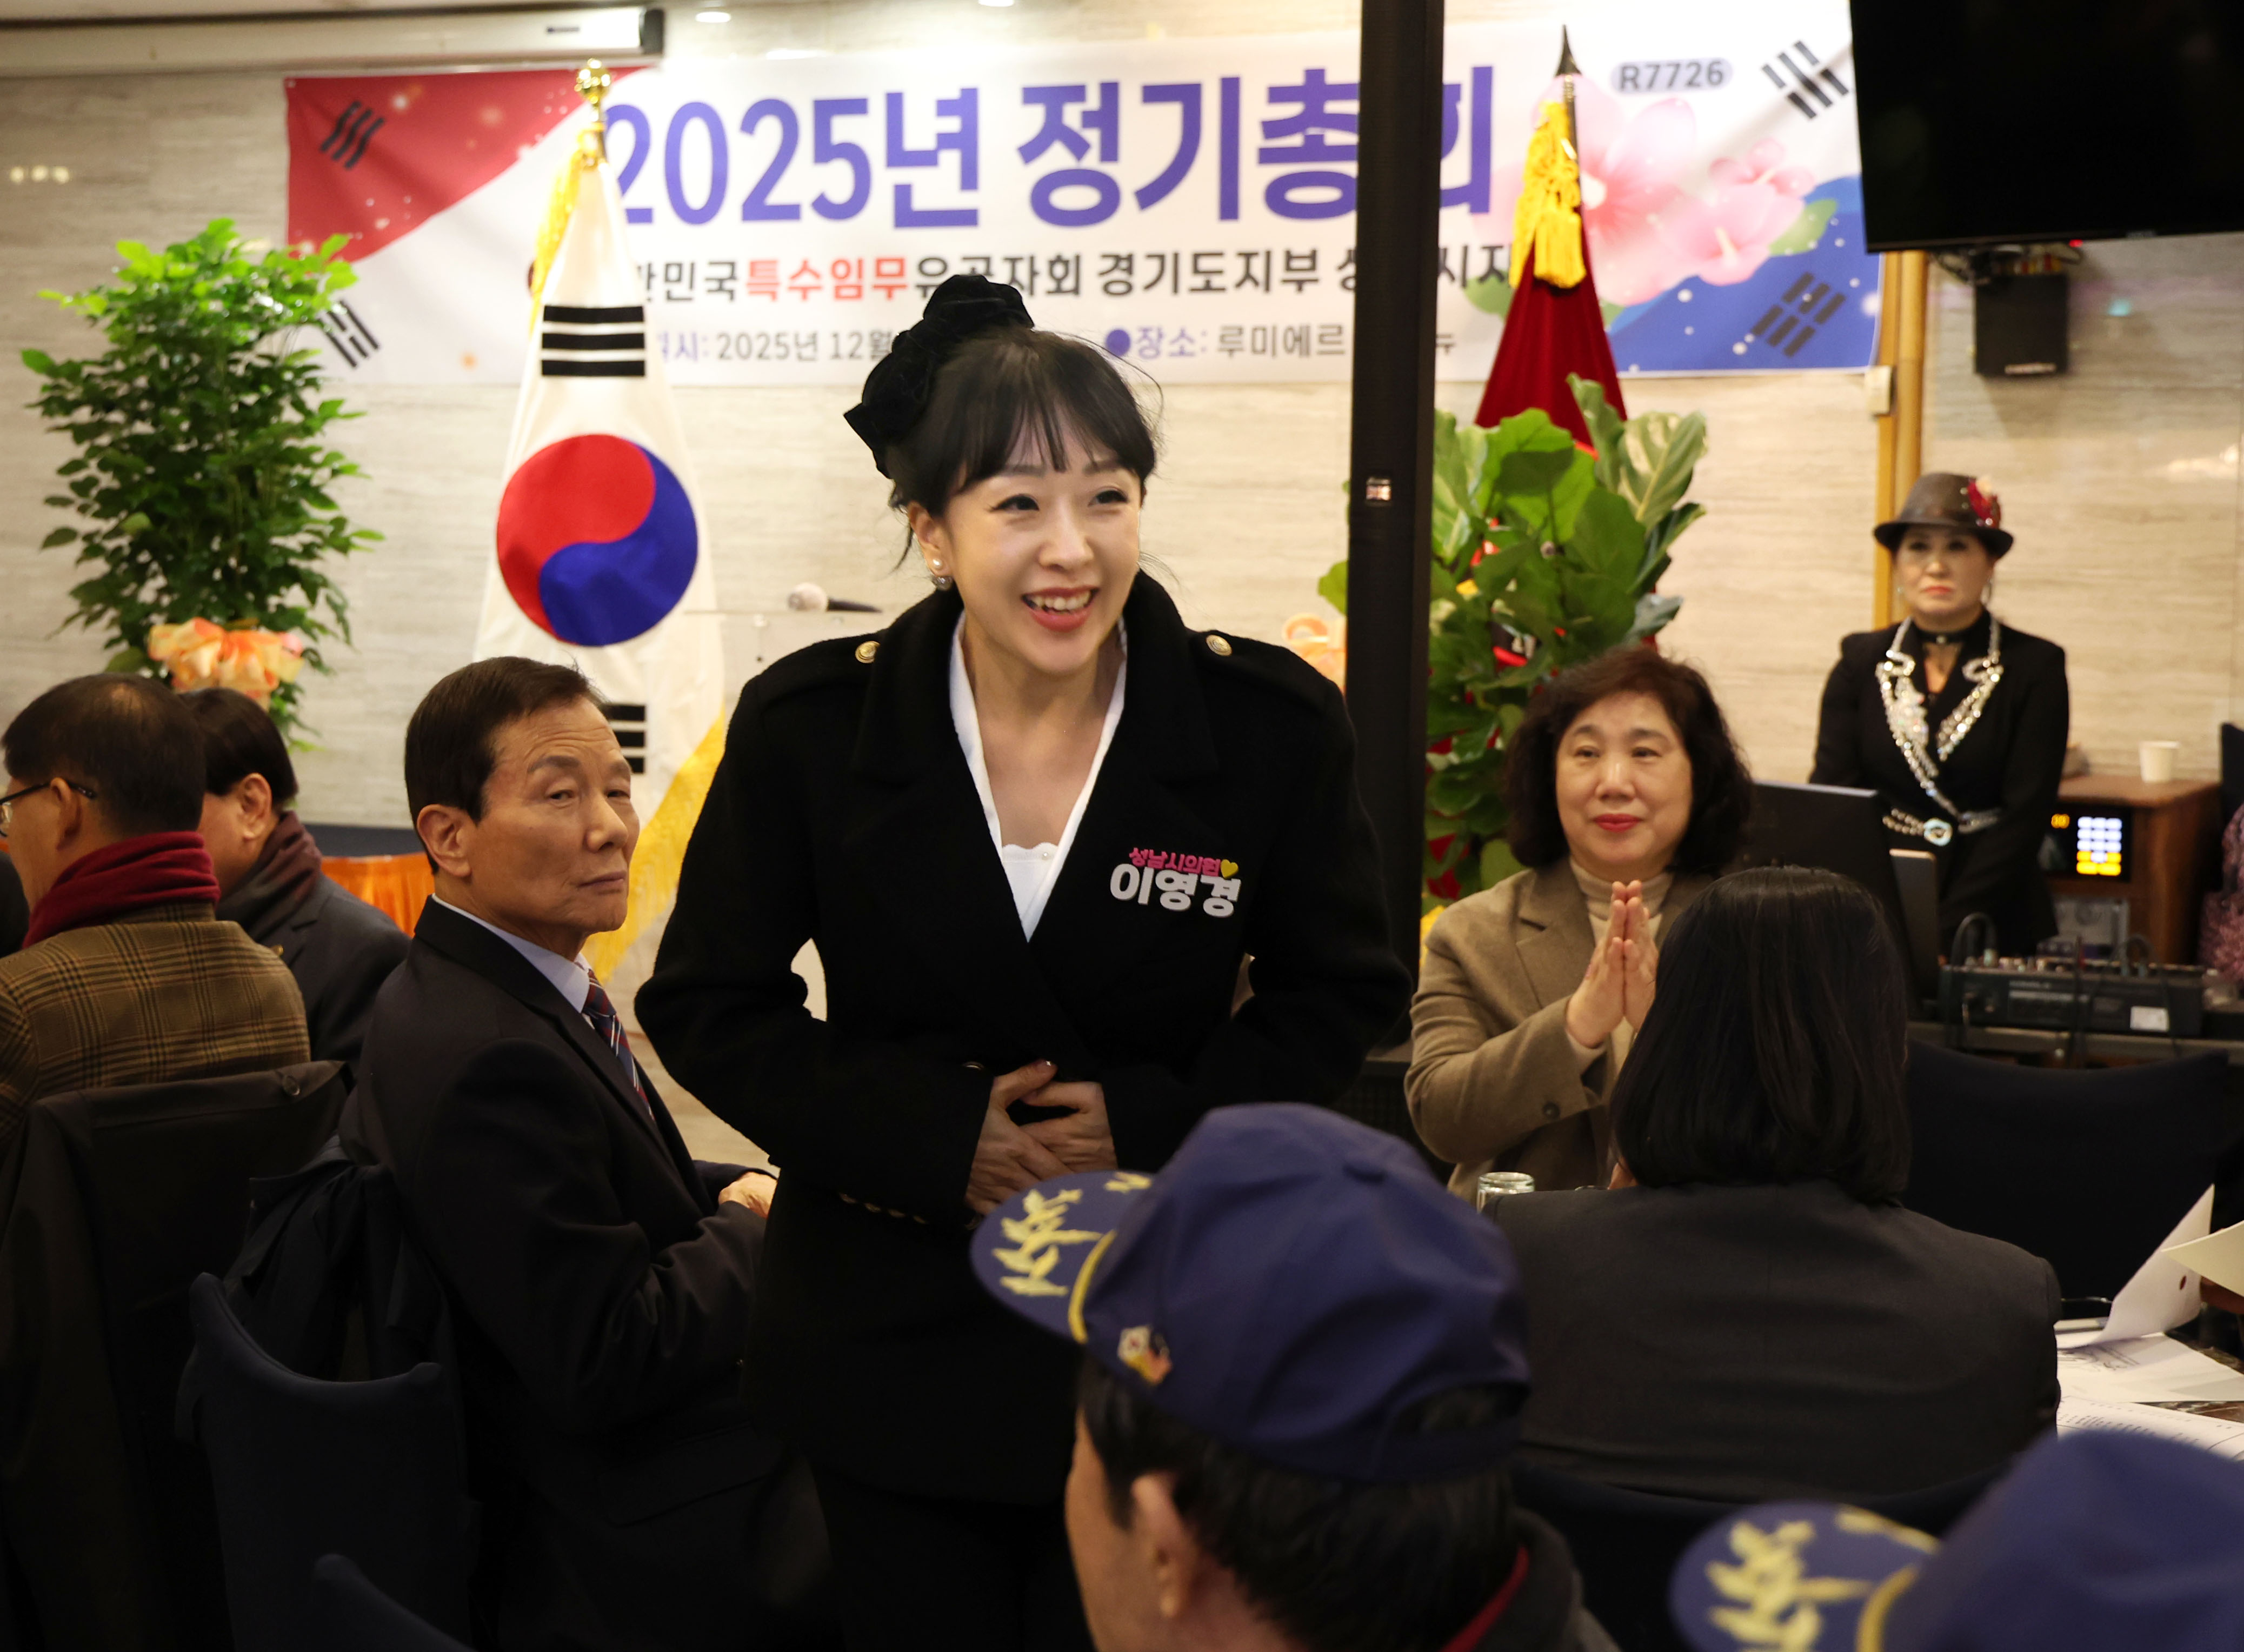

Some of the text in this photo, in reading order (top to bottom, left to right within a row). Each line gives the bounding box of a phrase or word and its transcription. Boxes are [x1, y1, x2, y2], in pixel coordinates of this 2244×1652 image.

[1618, 60, 1725, 91] R7726
[604, 65, 1494, 229] 2025년 정기총회
[1098, 249, 1320, 297] 경기도지부
[716, 330, 818, 362] 2025년
[1216, 323, 1347, 358] 루미에르
[1129, 847, 1221, 877] 성남시의원
[1110, 863, 1242, 918] 이영경
